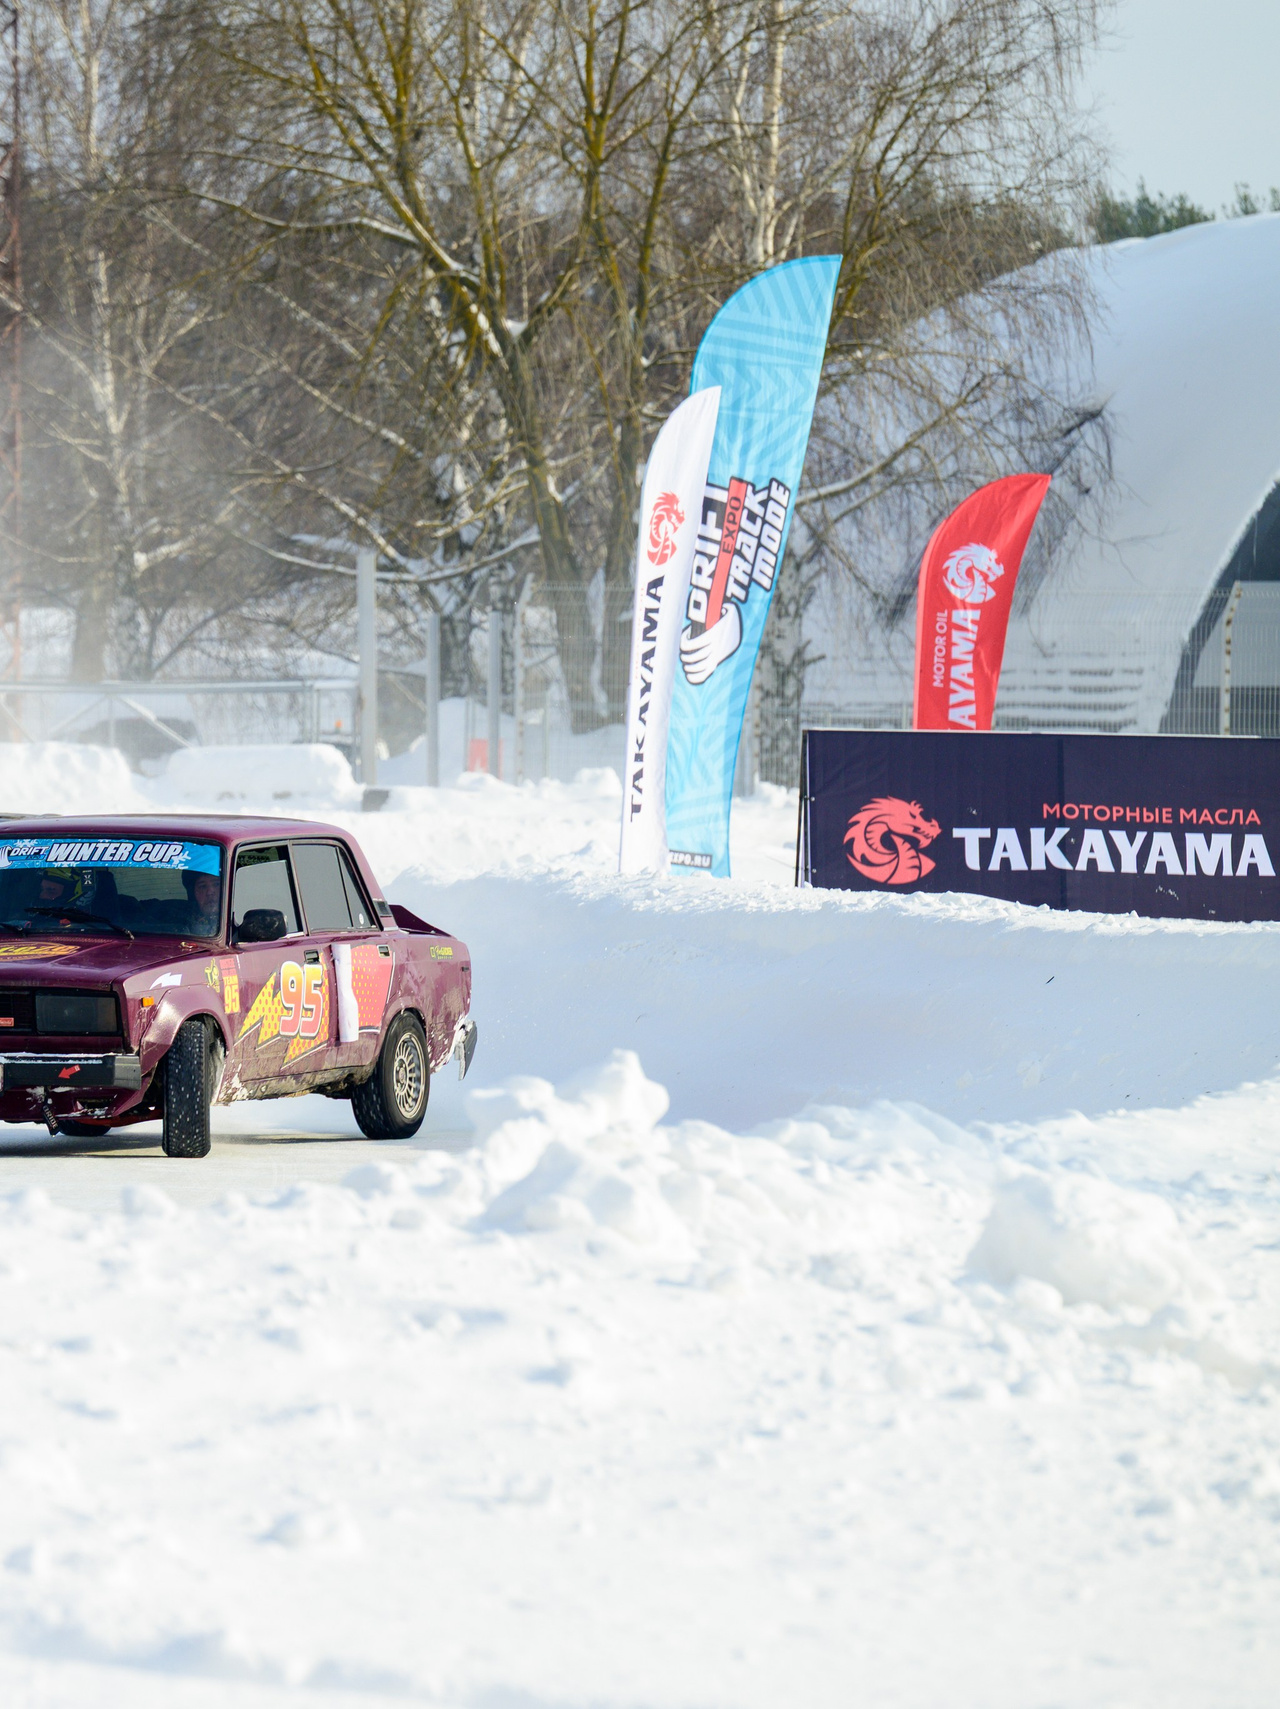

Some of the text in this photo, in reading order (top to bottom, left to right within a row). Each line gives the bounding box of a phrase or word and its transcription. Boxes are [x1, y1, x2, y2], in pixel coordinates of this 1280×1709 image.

[722, 496, 742, 555] EXPO
[725, 483, 770, 602] TRACK
[751, 479, 791, 592] MODE
[932, 609, 948, 688] MOTOR OIL
[948, 609, 981, 730] AYAMA
[630, 575, 666, 822] TAKAYAMA
[9, 843, 184, 863] DRIFT WINTER CUP
[952, 827, 1277, 877] TAKAYAMA
[1042, 803, 1262, 825] МОТОРНЫЕ МАСЛА
[224, 984, 240, 1014] 95
[280, 960, 324, 1038] 95
